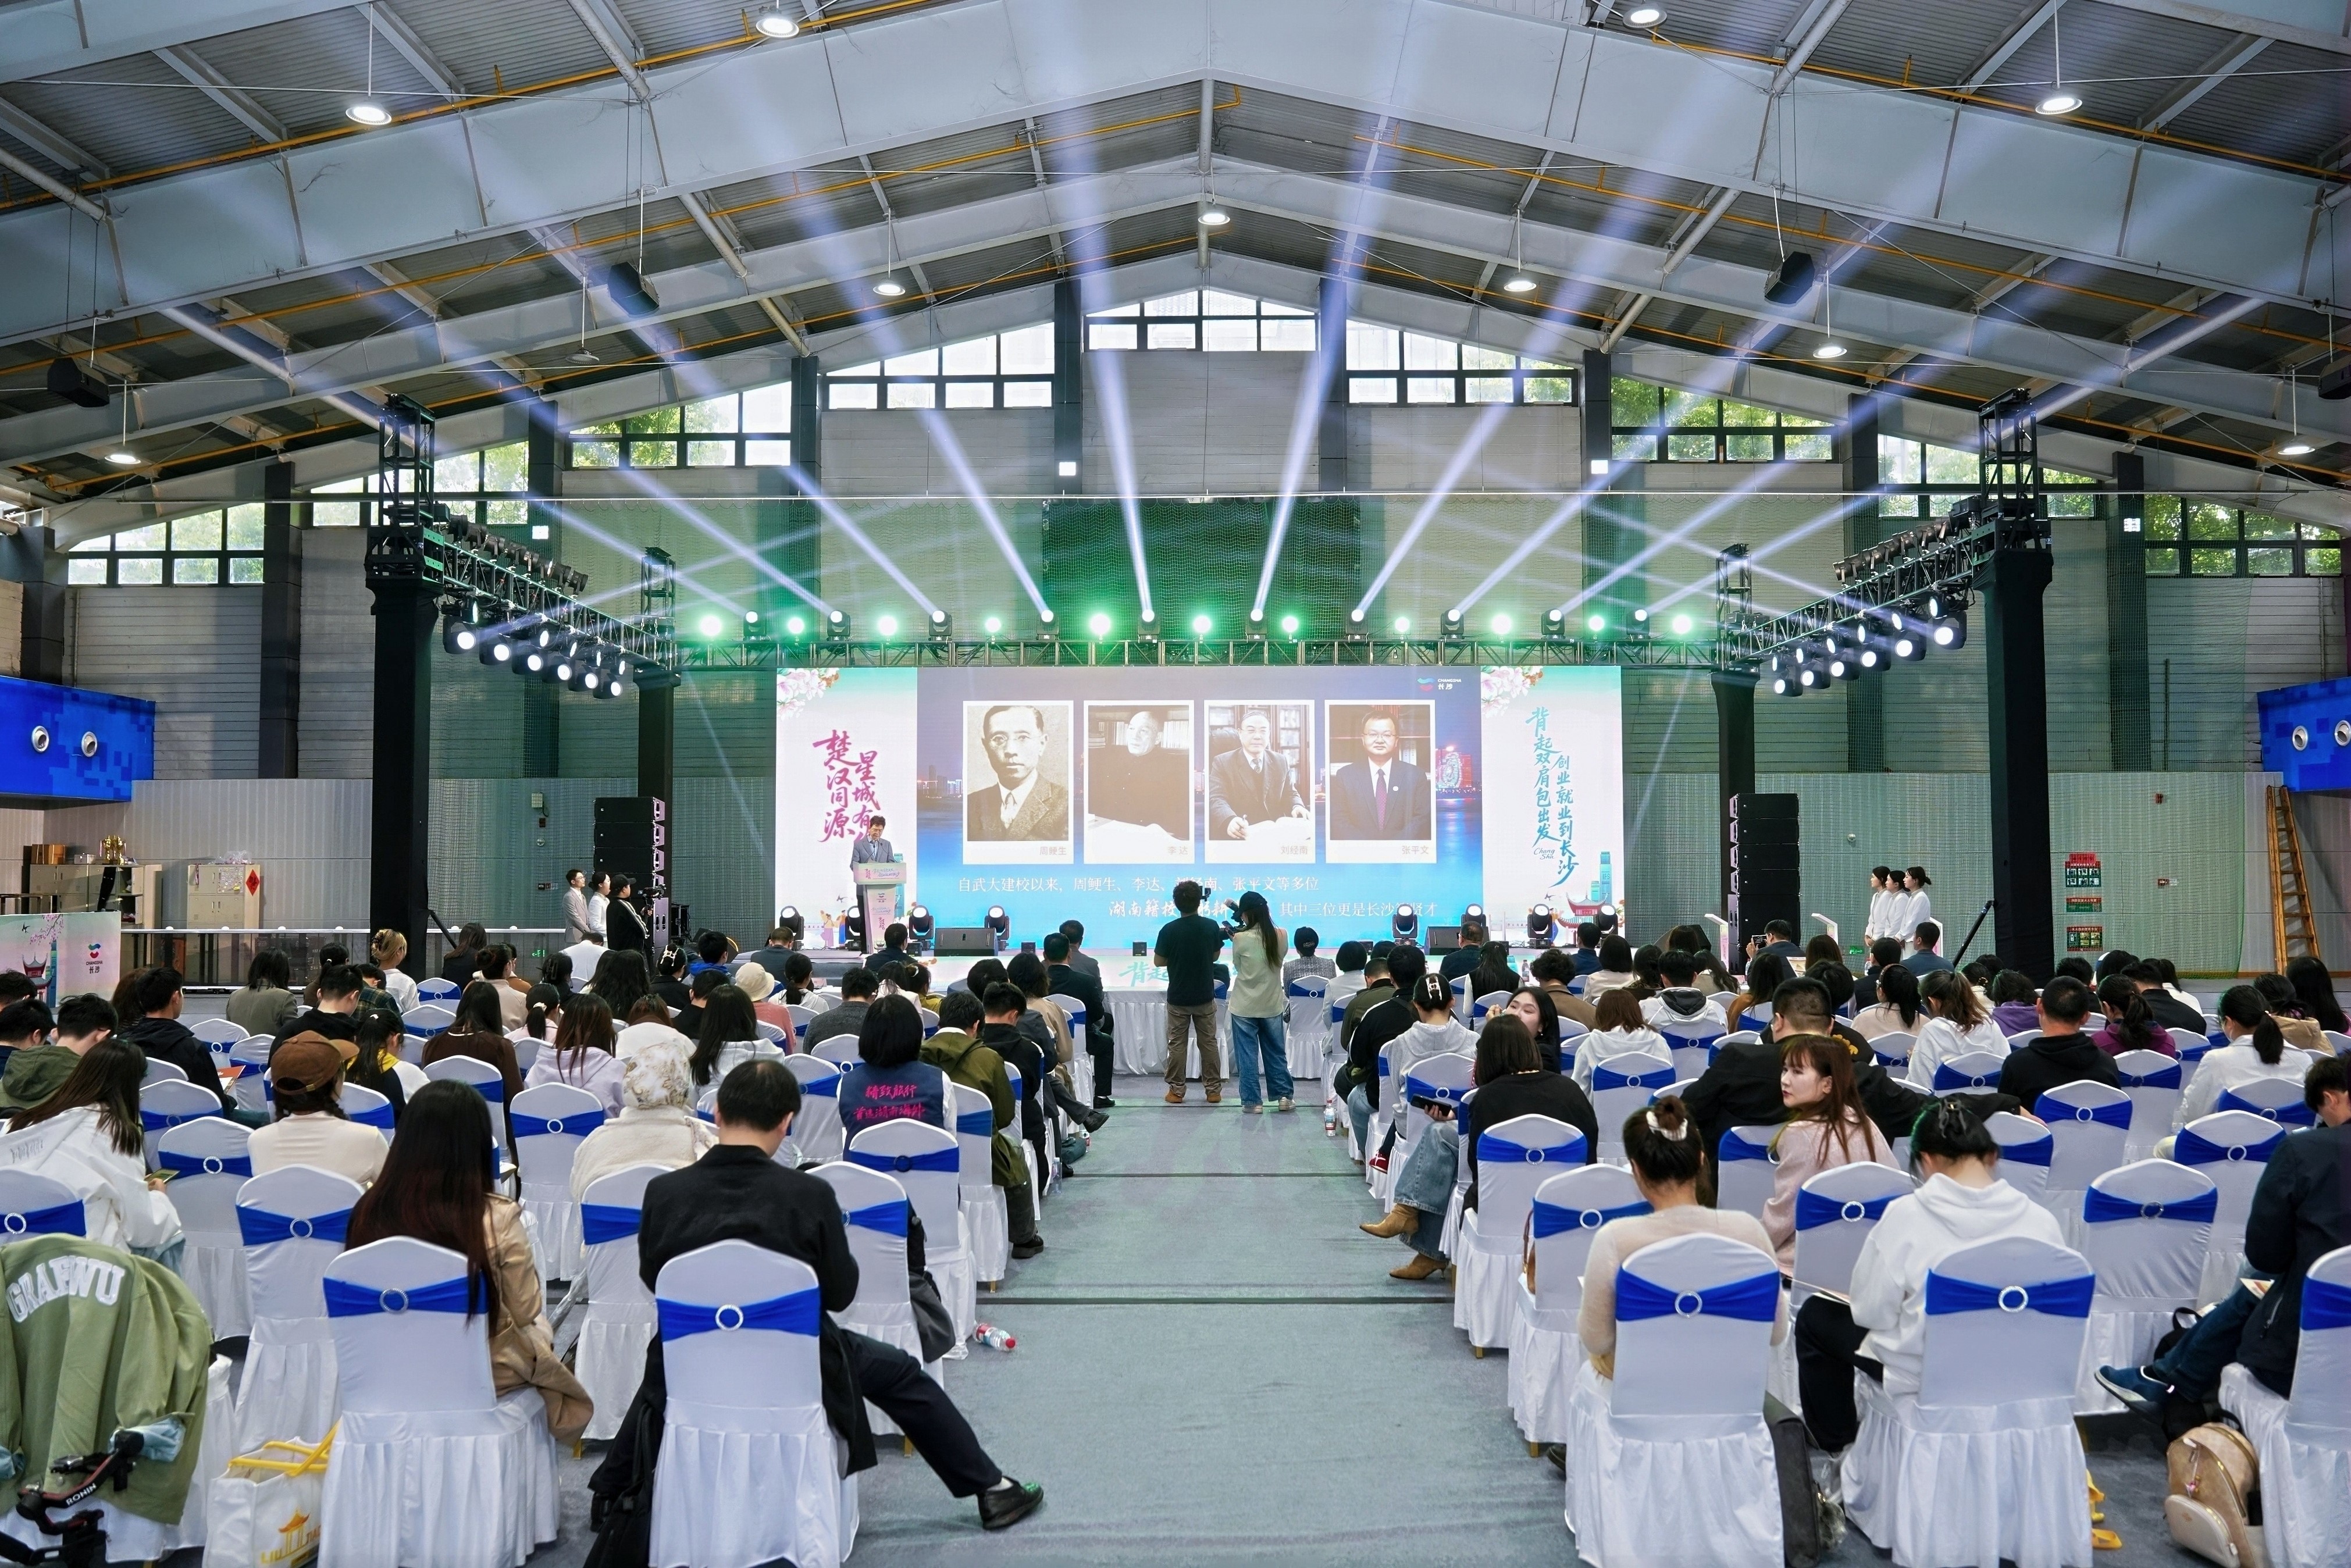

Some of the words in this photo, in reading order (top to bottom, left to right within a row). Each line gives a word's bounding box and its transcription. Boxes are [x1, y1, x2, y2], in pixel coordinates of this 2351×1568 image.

[813, 729, 862, 842] 楚汉同源
[1526, 706, 1562, 848] 背起双肩包出发
[851, 750, 881, 842] 星城有
[1548, 755, 1579, 888] 创业就业到长沙
[1039, 846, 1067, 856] 周鲠生
[1281, 845, 1308, 855] 刘经南
[1402, 845, 1429, 855] 张平文
[1280, 902, 1438, 917] 其中三位更是长沙贤才
[865, 1084, 917, 1099] 精致旅行
[66, 1483, 97, 1505] RONIN
